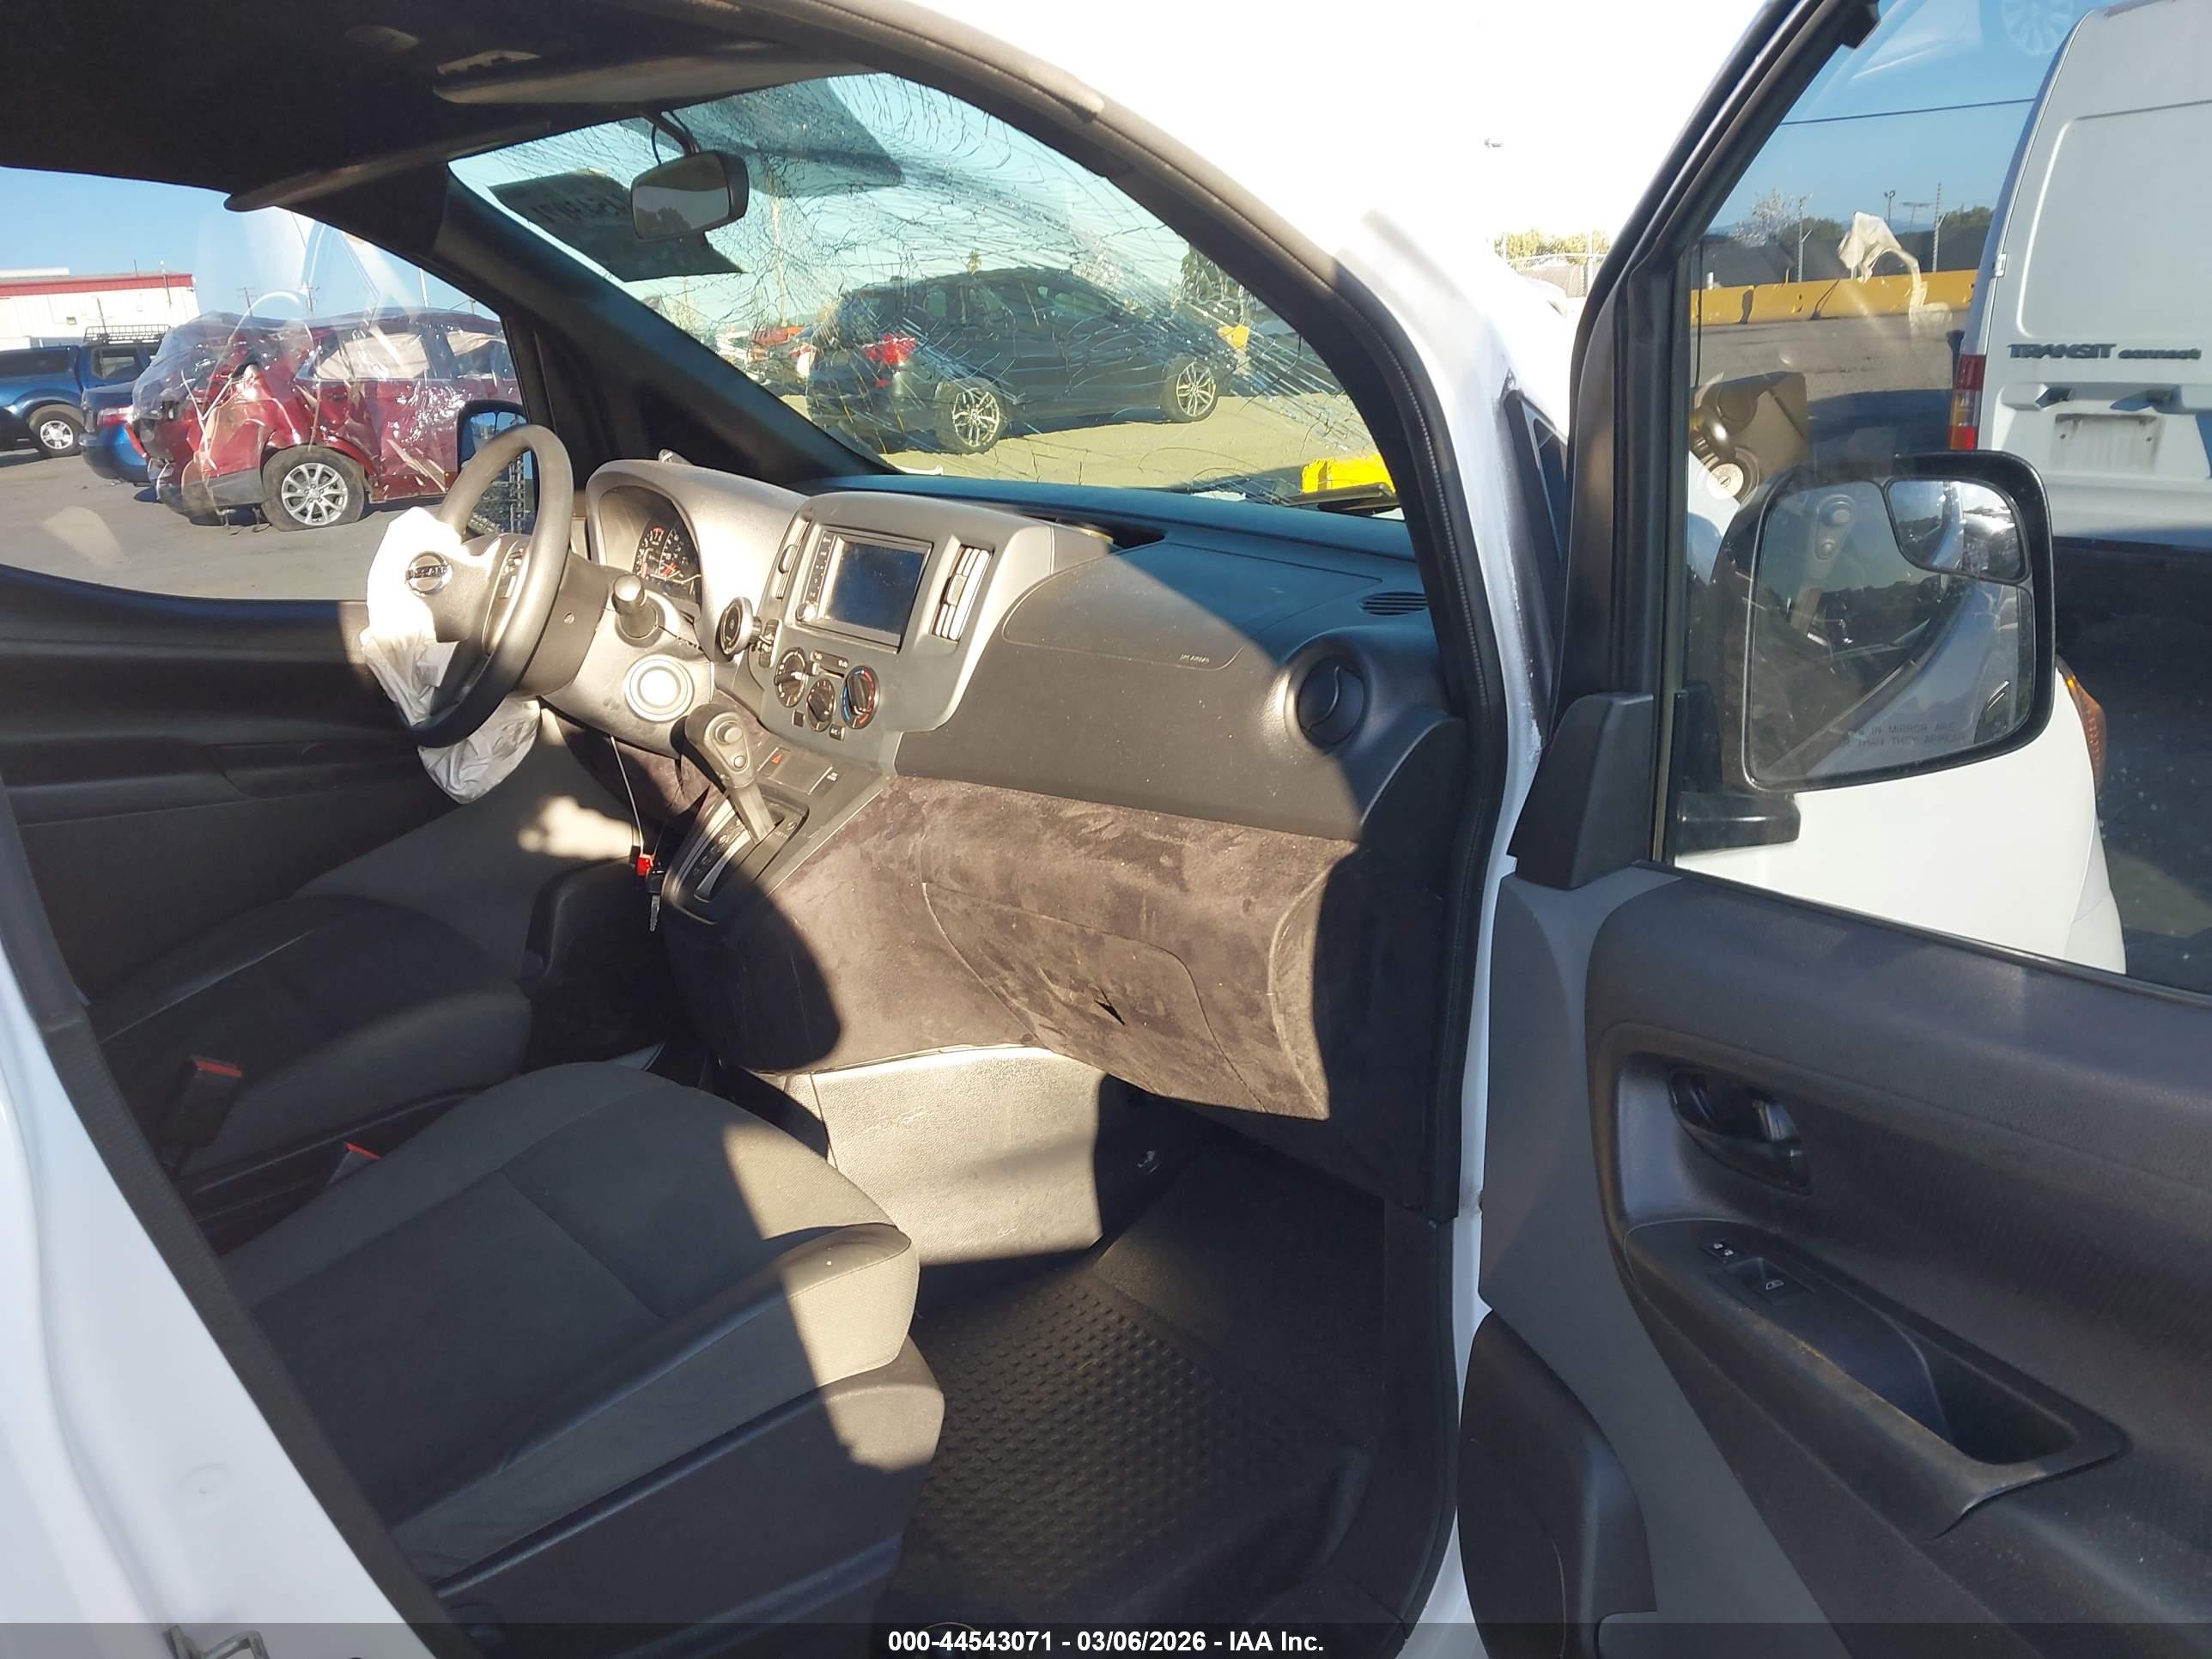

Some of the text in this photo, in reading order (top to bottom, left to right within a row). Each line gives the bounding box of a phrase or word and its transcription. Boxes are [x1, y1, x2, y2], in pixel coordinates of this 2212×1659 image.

[2007, 343, 2117, 359] TRANSIT
[1888, 723, 1929, 733] MIRROR
[1934, 721, 1955, 732] ARE
[1923, 734, 1966, 744] APPEAR
